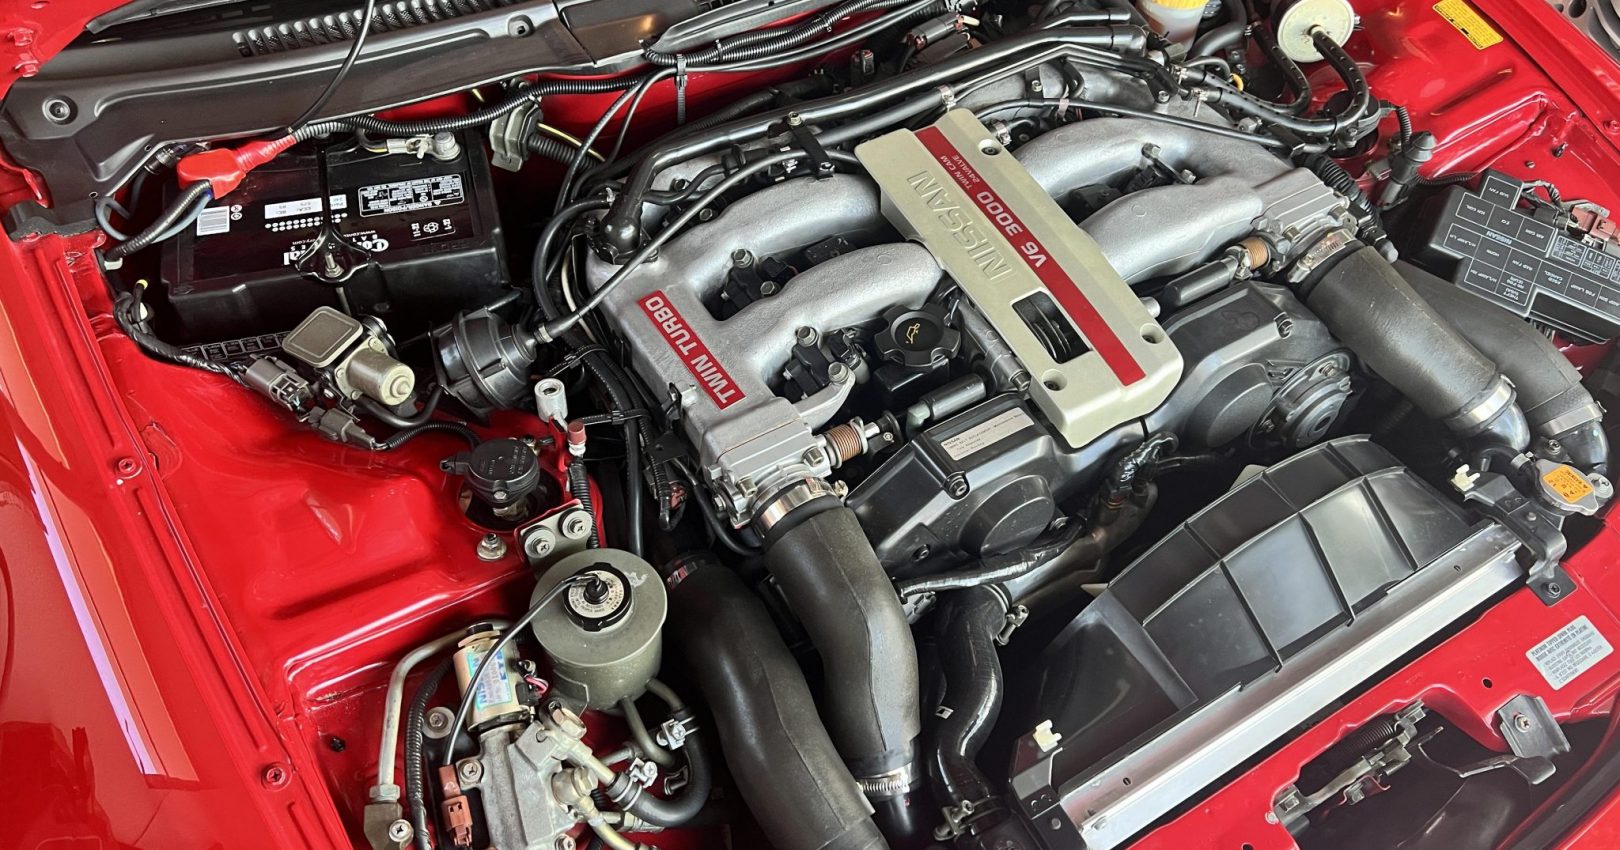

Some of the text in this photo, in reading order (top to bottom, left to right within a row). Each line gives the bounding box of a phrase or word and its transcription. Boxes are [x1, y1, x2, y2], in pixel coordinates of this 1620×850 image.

[940, 155, 972, 189] TWIN CAM
[952, 154, 980, 183] 24VALVE
[907, 170, 1013, 281] NISSAN
[976, 191, 1047, 268] V6 3000
[1486, 230, 1513, 245] NISSAN
[645, 296, 736, 404] TWIN TURBO
